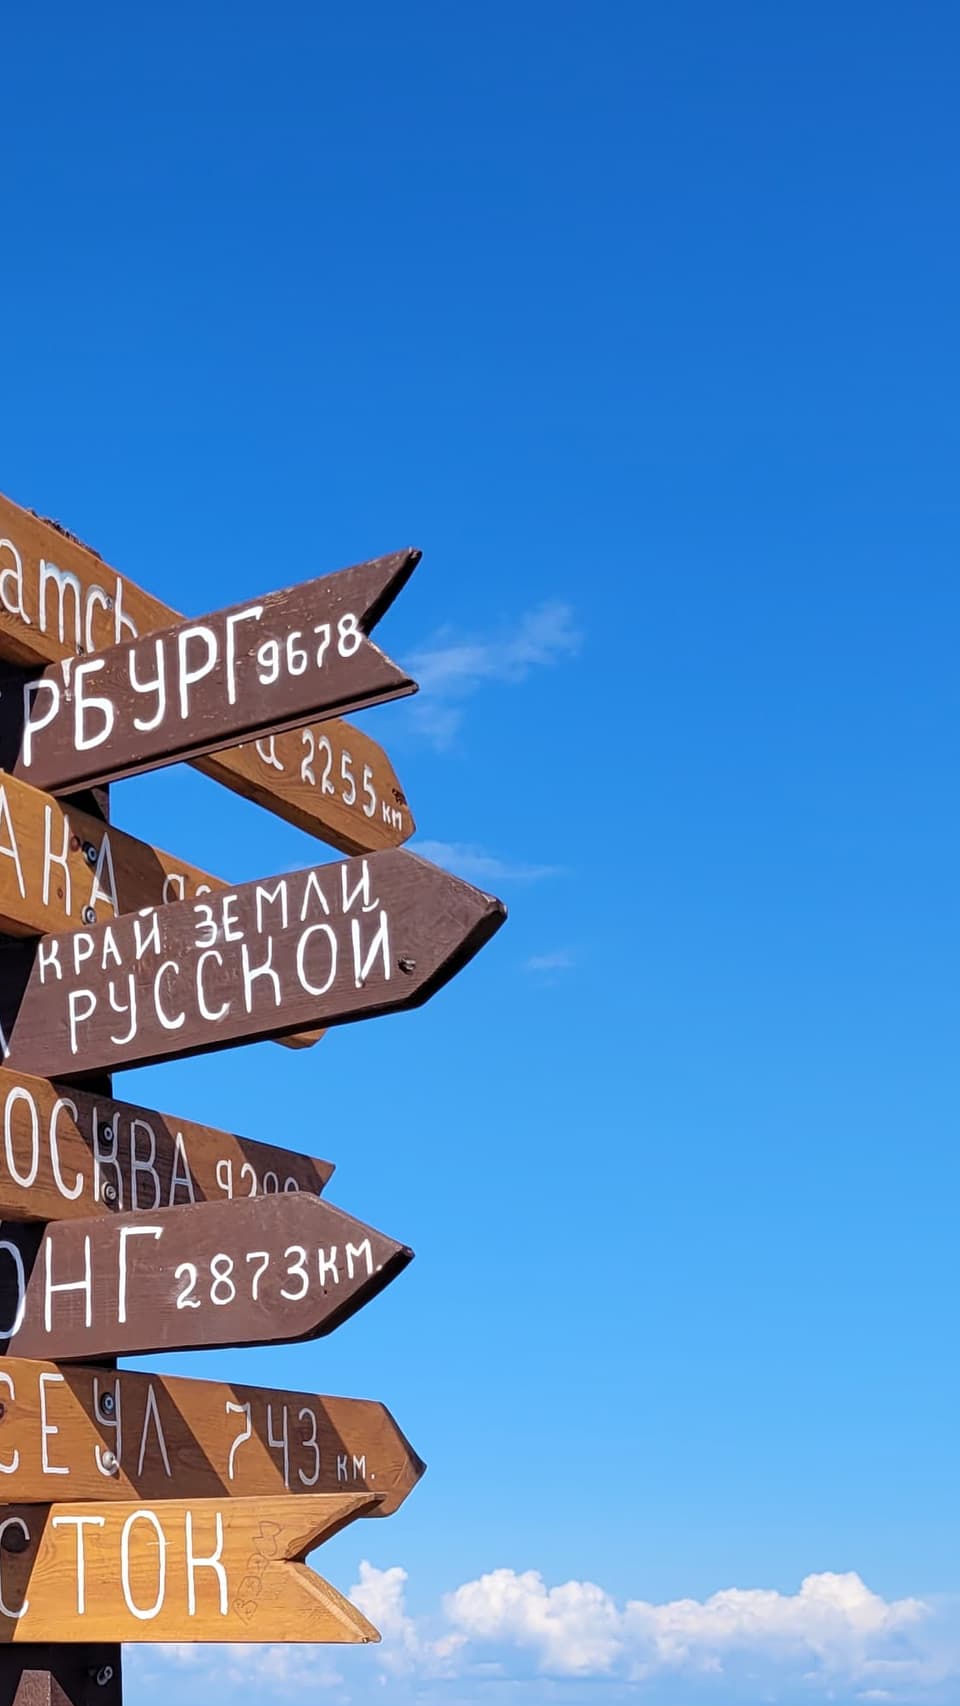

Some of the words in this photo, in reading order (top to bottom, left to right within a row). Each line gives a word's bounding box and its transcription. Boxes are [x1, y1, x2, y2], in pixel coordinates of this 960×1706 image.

[257, 613, 363, 685] 9678
[300, 728, 377, 818] 2255
[39, 906, 160, 984] КРАЙ
[193, 860, 372, 949] ЗЕМЛИ
[225, 1401, 321, 1489] 743
